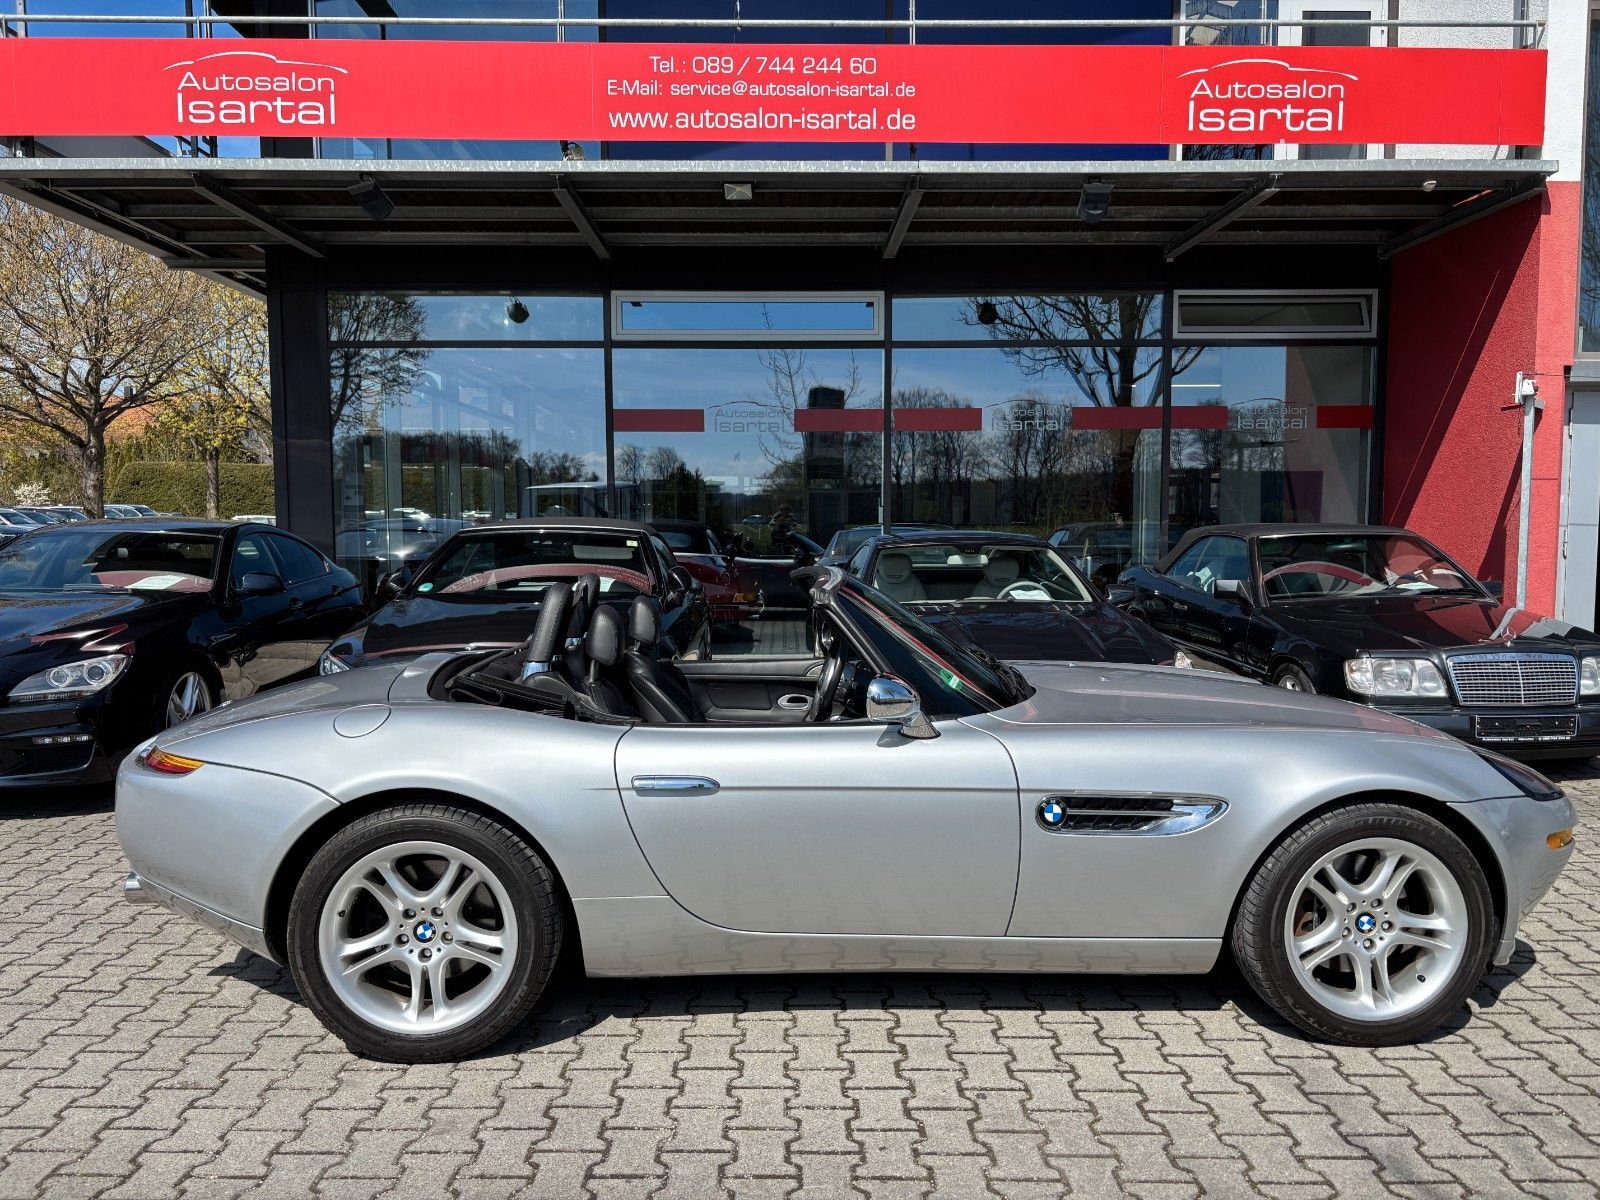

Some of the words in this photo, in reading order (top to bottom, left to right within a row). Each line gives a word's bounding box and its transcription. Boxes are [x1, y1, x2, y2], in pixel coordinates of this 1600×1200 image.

[649, 56, 686, 73] Tel.:
[692, 56, 734, 74] 089
[737, 57, 750, 75] /
[756, 56, 796, 75] 744
[802, 57, 842, 75] 244
[849, 57, 877, 75] 60
[177, 71, 335, 92] Autosalon
[607, 79, 663, 96] E-Mail:
[670, 80, 916, 98] service@autosalon-isartal.de
[1190, 79, 1345, 99] Autosalon
[177, 92, 336, 125] Isartal
[608, 106, 916, 130] www.autosalon-isartal.de
[1188, 100, 1344, 132] Isartal
[993, 407, 1064, 417] tosalon
[714, 418, 785, 433] Isartal
[1237, 415, 1308, 429] Isartal
